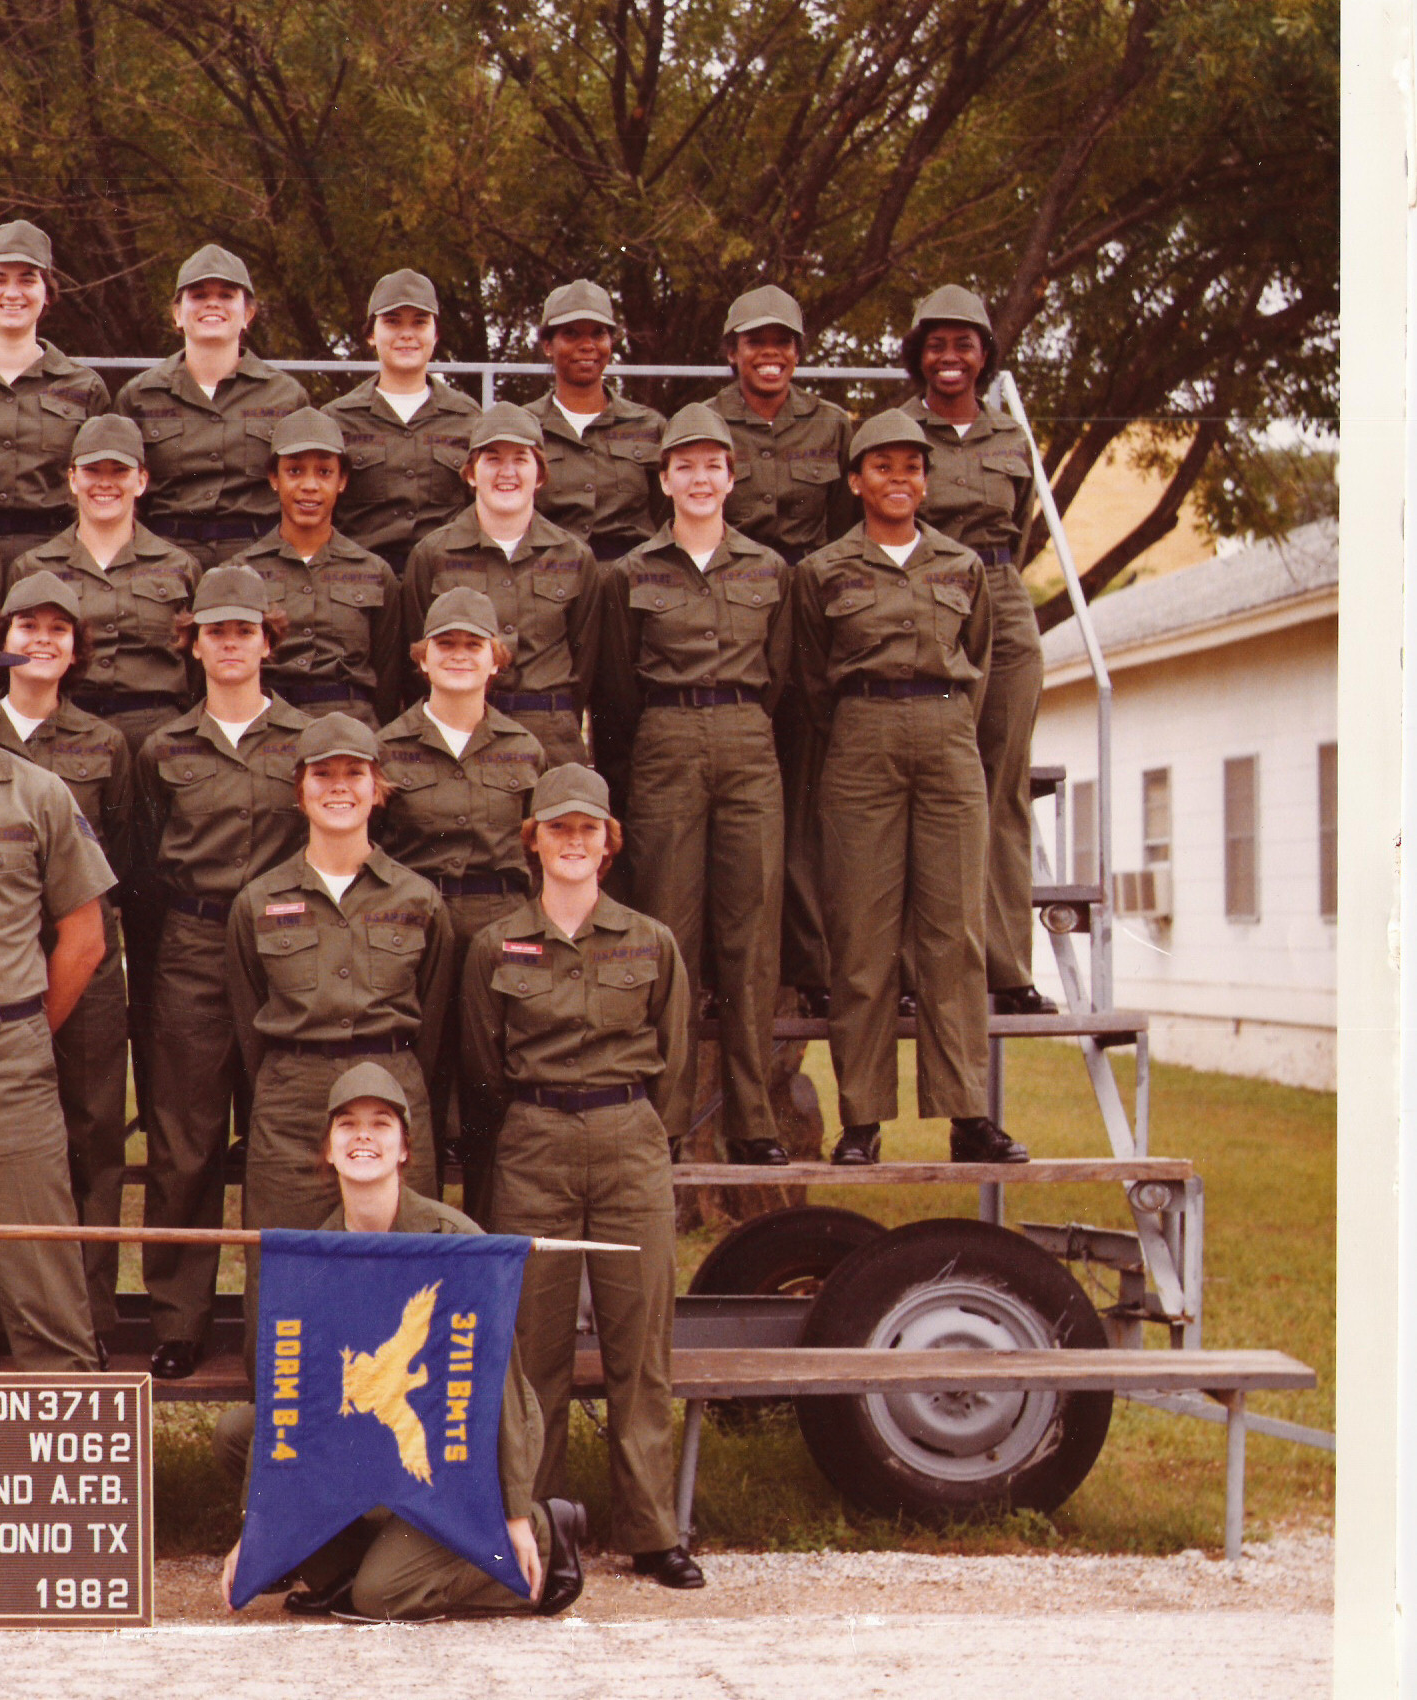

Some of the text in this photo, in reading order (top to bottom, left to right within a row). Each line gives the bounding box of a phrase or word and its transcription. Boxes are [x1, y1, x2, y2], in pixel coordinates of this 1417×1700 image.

[272, 1318, 301, 1461] DORM B-4
[444, 1312, 476, 1462] 3711 BMTS
[39, 1392, 124, 1420] 3711
[51, 1475, 127, 1504] A.F.B.
[88, 1524, 127, 1552] TX
[37, 1579, 128, 1608] 1982
